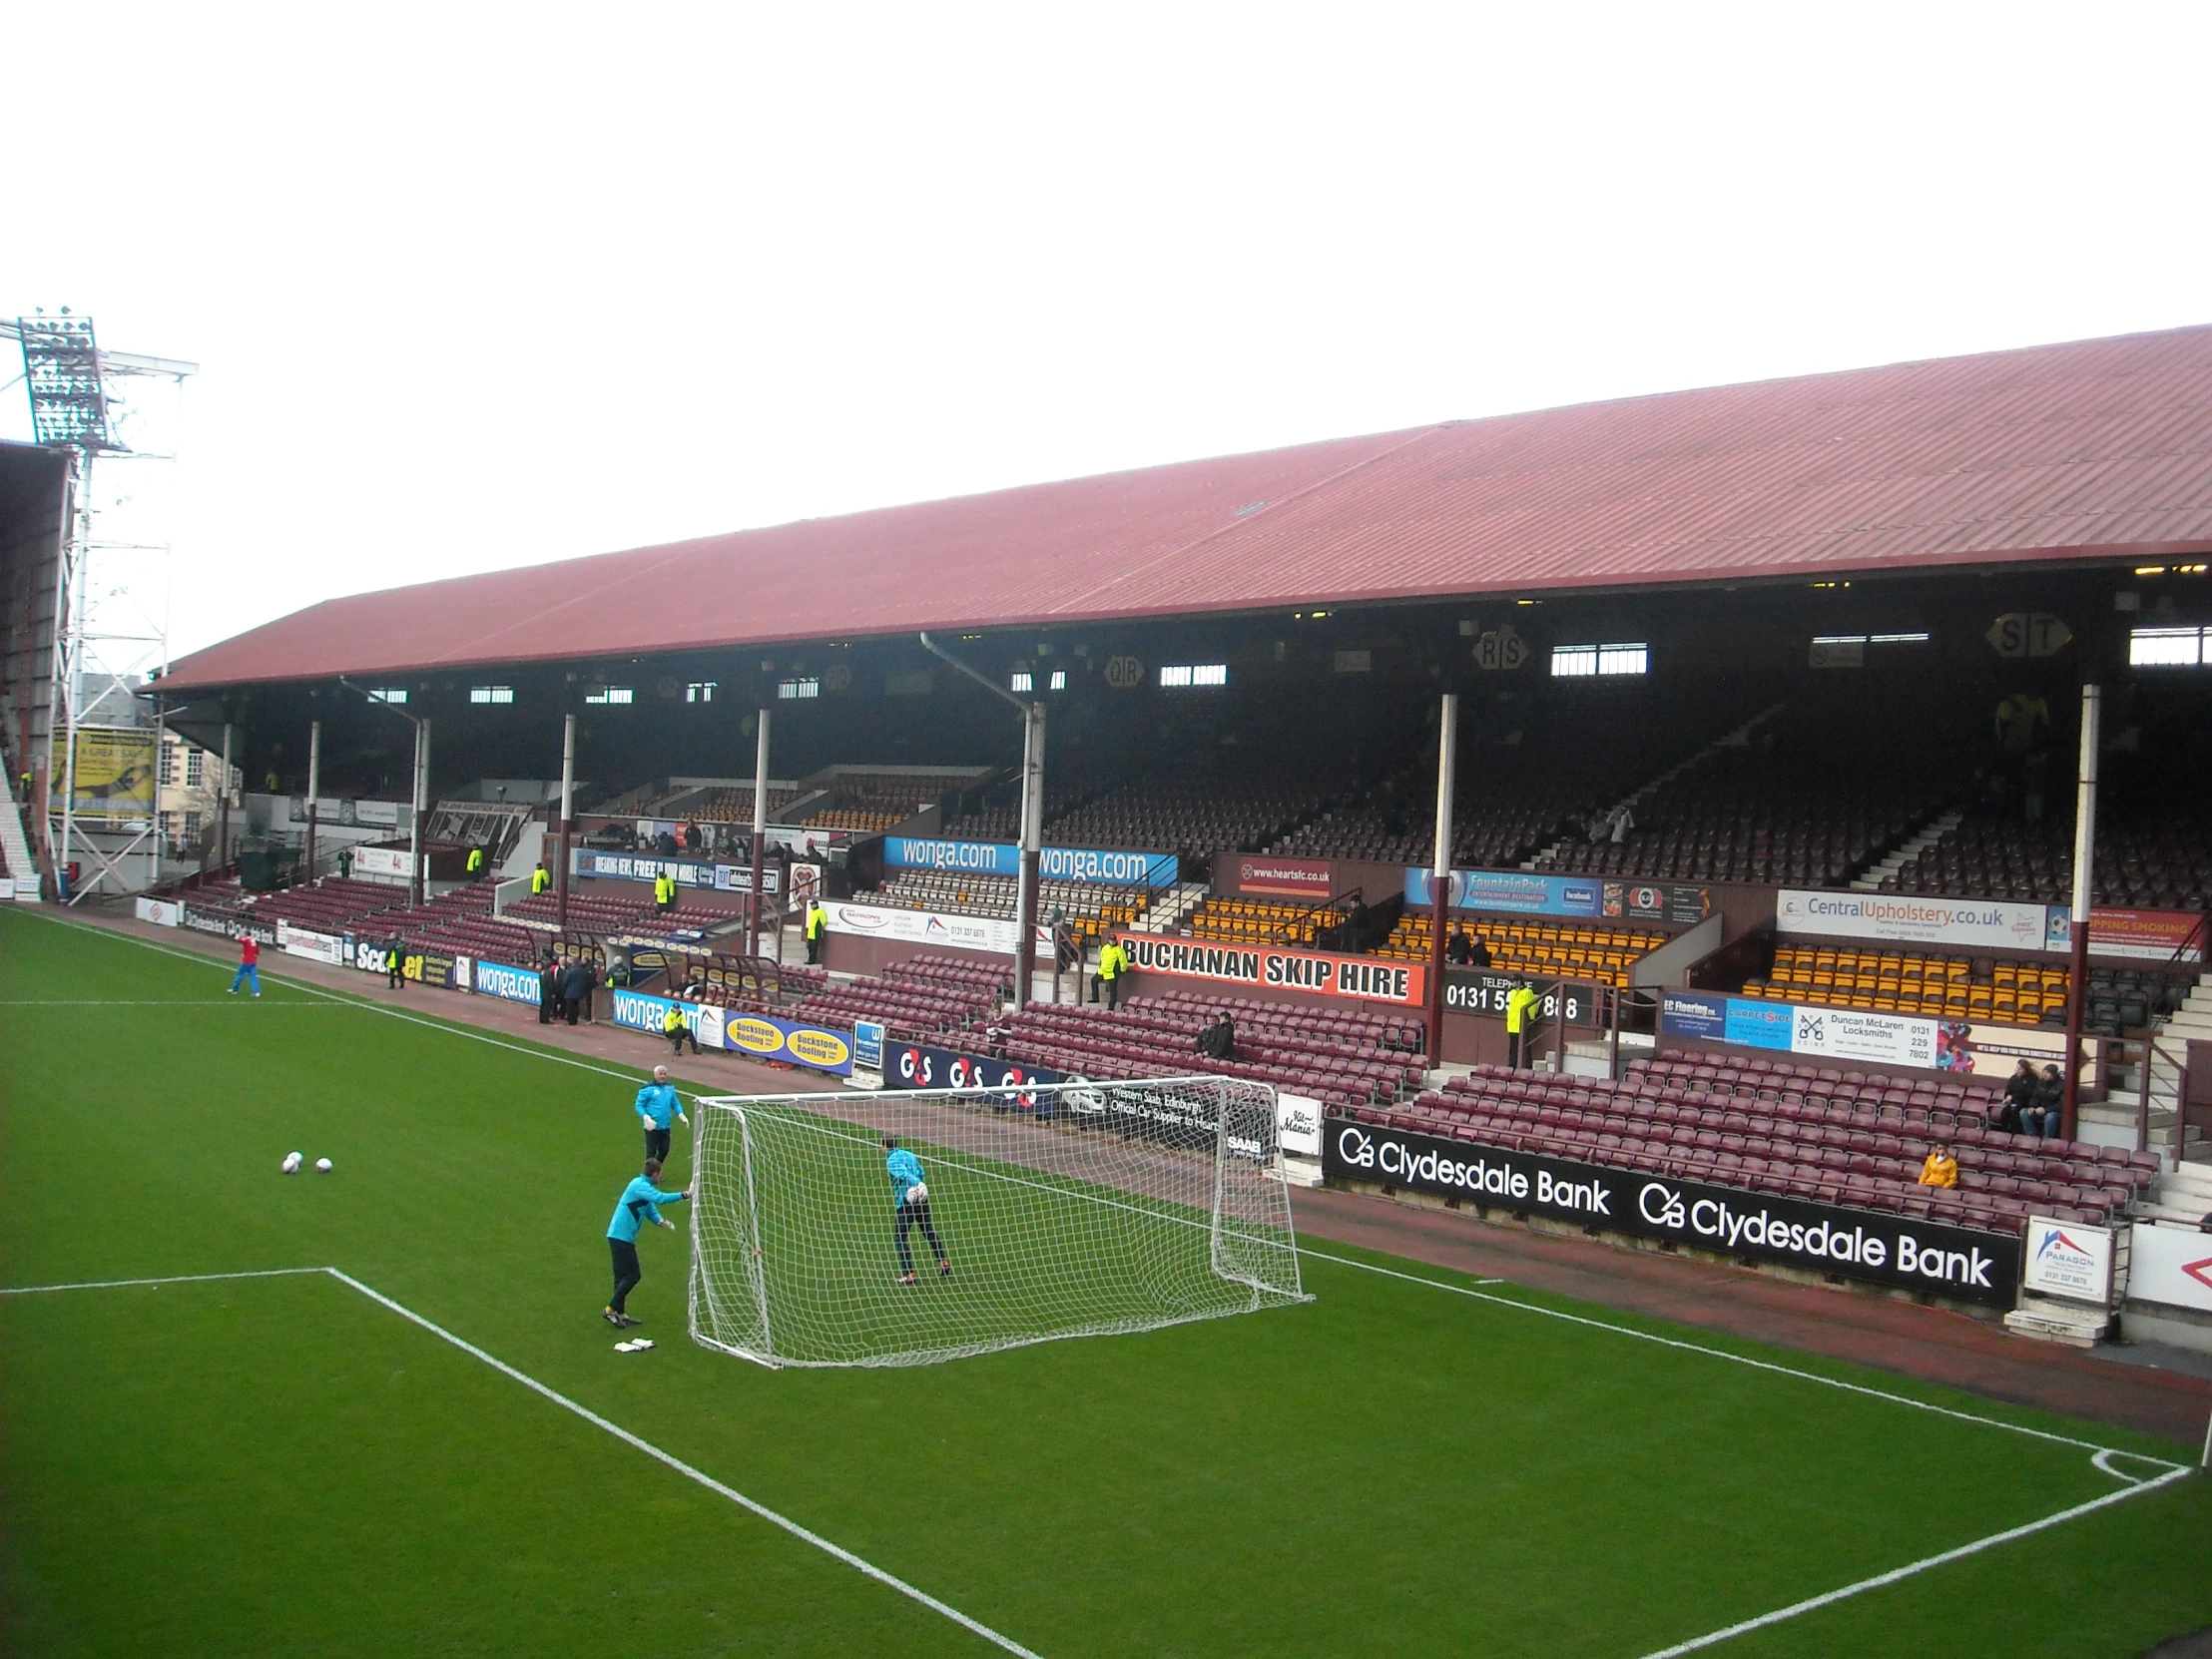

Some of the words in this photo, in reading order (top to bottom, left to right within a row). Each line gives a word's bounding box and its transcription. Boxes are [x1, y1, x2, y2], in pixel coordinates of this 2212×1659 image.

[2001, 620, 2019, 652] S
[2036, 618, 2054, 648] T
[1482, 638, 1495, 663] R
[1505, 638, 1519, 663] S
[1126, 661, 1138, 683] R
[903, 839, 996, 869] wonga.com
[634, 859, 656, 877] FREE
[1254, 867, 1330, 882] www.heartsfc.co.uk
[1471, 875, 1547, 892] FountainPark
[1566, 890, 1592, 900] facebook
[1809, 897, 2003, 926] CentralUpholstery.co.uk
[951, 925, 962, 935] 0131
[963, 927, 973, 936] 337
[2132, 921, 2188, 935] SMOKING
[1120, 938, 1260, 981] BUCHANAN
[1264, 954, 1333, 989] SKIP
[1338, 963, 1409, 1000] HIRE
[1446, 984, 1487, 1009] 0131
[1664, 999, 1674, 1011] EC
[1675, 1001, 1708, 1016] Flooring
[737, 1022, 775, 1037] Buckstone
[1831, 1014, 1864, 1026] Duncan
[1866, 1017, 1904, 1030] McLaren
[1911, 1025, 1930, 1035] 0131
[737, 1031, 764, 1046] Roofing
[1843, 1025, 1894, 1039] Locksmiths
[797, 1034, 838, 1050] Buckstone
[1911, 1037, 1929, 1047] 229
[797, 1044, 827, 1059] Roofing
[1910, 1049, 1930, 1060] 7802
[900, 1048, 932, 1086] G4S
[1112, 1088, 1142, 1101] Western
[1111, 1100, 1137, 1115] Official
[1138, 1105, 1151, 1118] Car
[1153, 1108, 1183, 1125] Supplier
[1185, 1114, 1193, 1126] to
[1281, 1117, 1316, 1136] Mania
[1228, 1136, 1262, 1153] SAAB
[1379, 1141, 1529, 1199] Clydesdale
[1537, 1170, 1611, 1216] Bank
[1691, 1199, 1887, 1268] Clydesdale
[1897, 1235, 1993, 1289] Bank
[2045, 1251, 2094, 1267] PARAGON
[2044, 1270, 2059, 1280] 0131
